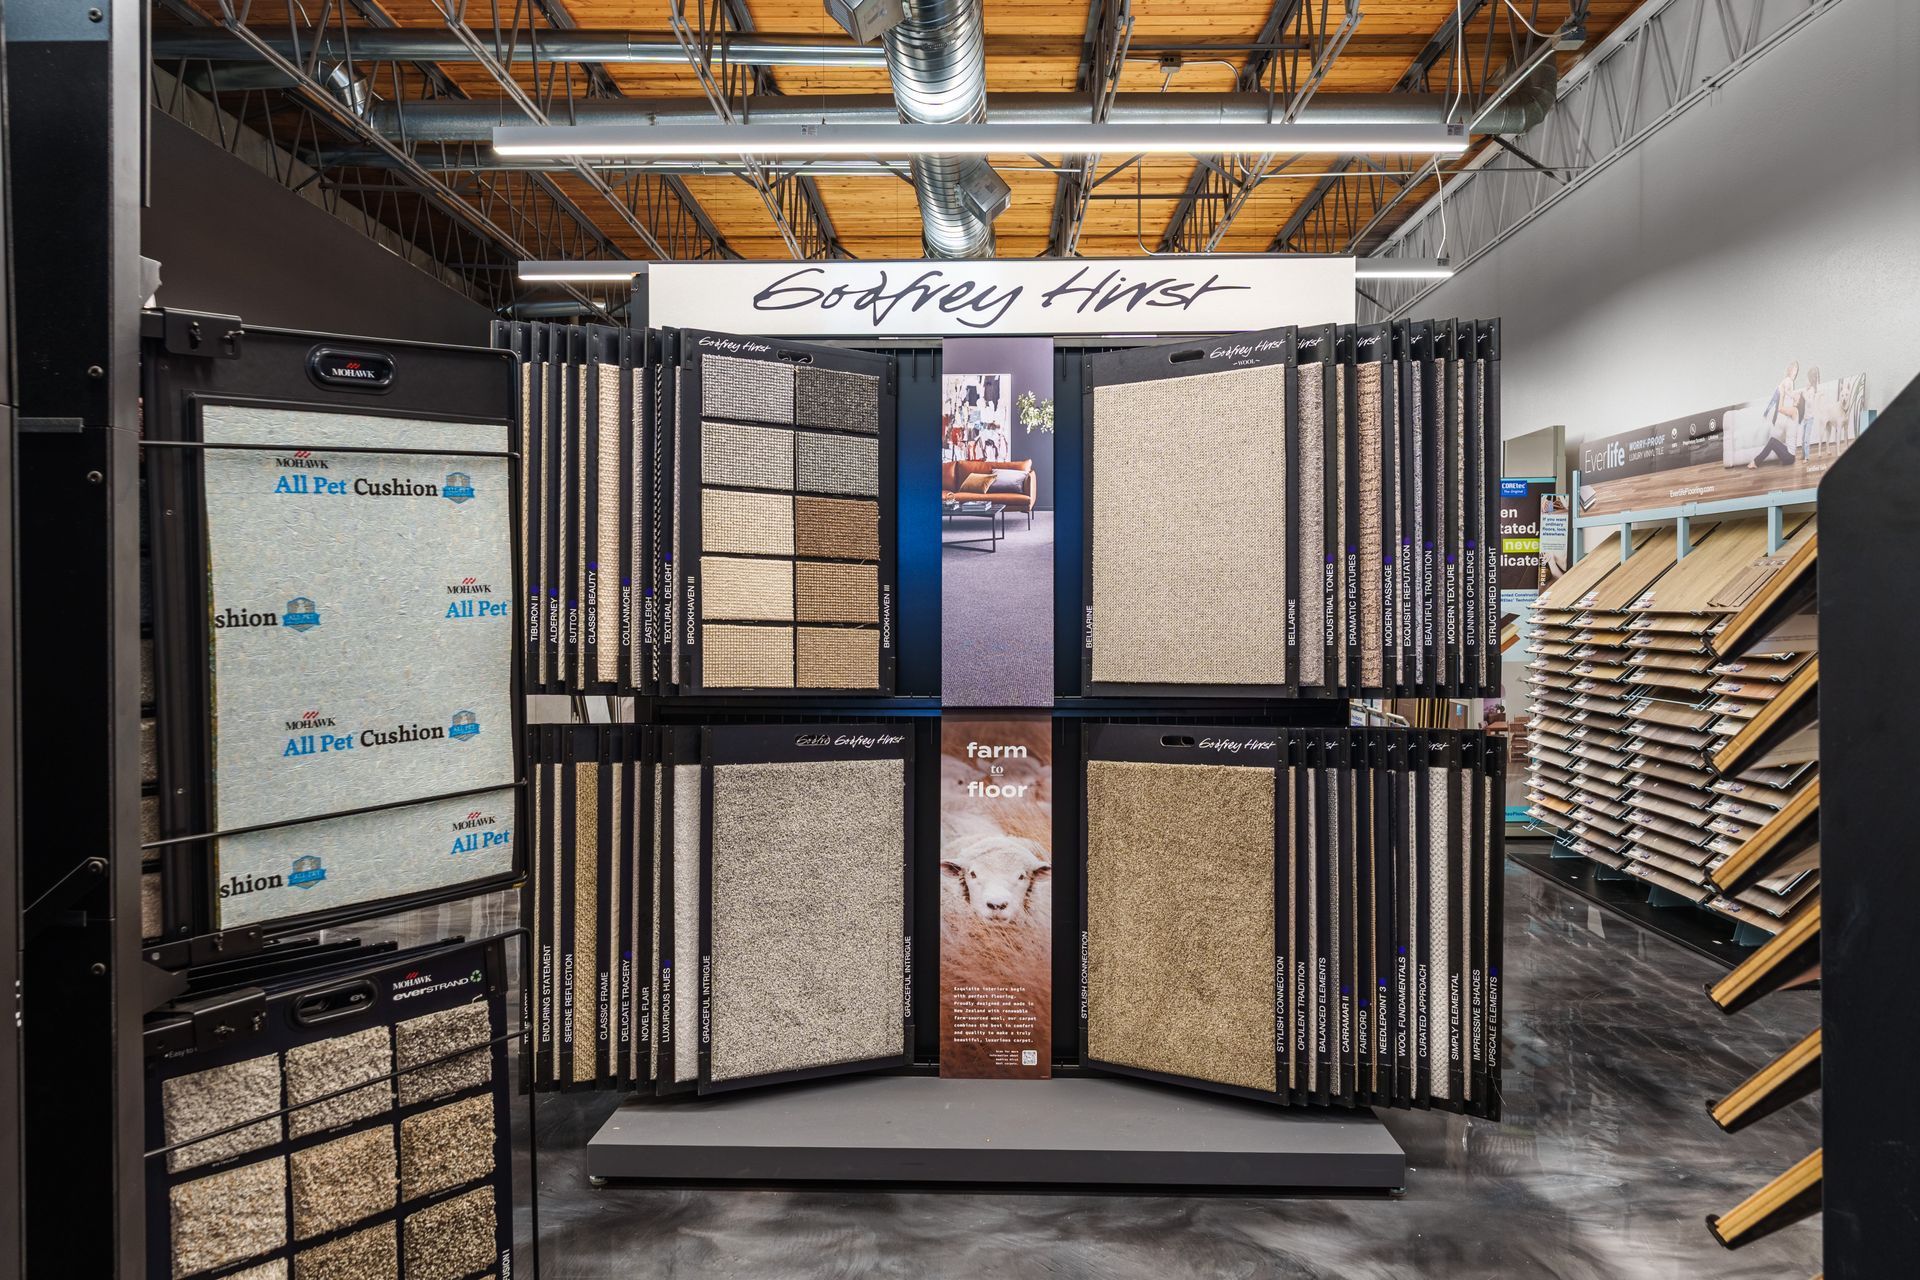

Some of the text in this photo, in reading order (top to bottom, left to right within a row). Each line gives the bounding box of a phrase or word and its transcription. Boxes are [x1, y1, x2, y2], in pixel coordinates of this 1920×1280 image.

[753, 266, 1251, 328] Godfrey Hirst
[698, 337, 772, 353] Godfrey Hirst
[1209, 338, 1286, 359] Godfrey Hirst
[1237, 358, 1255, 366] WOOL
[332, 367, 375, 379] MOHAWK
[275, 456, 330, 469] MOHAWK
[1585, 441, 1625, 473] Everlife
[274, 474, 438, 498] All Pet Cushion
[445, 600, 508, 619] All Pet
[447, 584, 492, 595] MOHAWK
[1326, 563, 1334, 646] INDUSTRIAL TONES
[1348, 554, 1357, 646] DRAMATIC FEATURES
[1384, 565, 1393, 646] MODERN PASSAGE
[1403, 544, 1412, 647] EXQUISITE REPUTATION
[1425, 550, 1433, 646] BEAUTIFUL TRADITION
[1447, 564, 1455, 644] MODERN TEXTURE
[1467, 550, 1475, 646] STUNNING OPULENCE
[1489, 547, 1497, 645] STRUCTURED DELIGHT
[530, 602, 538, 641] TIBURON
[588, 607, 596, 644] CLASSIC
[664, 601, 672, 644] TEXTURAL
[687, 586, 695, 645] BROOKHAVEN
[1086, 605, 1094, 648] BELLARINE
[1288, 599, 1296, 646] BELLARINE
[283, 726, 445, 757] All Pet Cushion
[285, 717, 337, 731] MOHAWK
[834, 734, 905, 748] Godfrey Hirst
[966, 742, 1027, 758] farm
[1198, 738, 1242, 753] Godfrey
[1244, 738, 1276, 750] Hirst
[967, 781, 1028, 798] floor
[990, 765, 1004, 774] to
[450, 830, 511, 855] All Pet
[452, 816, 496, 832] MOHAWK
[392, 974, 432, 991] MOHAWK
[392, 977, 469, 1001] everSTRAND
[543, 945, 551, 1042] ENDURING STATEMENT
[565, 954, 573, 1043] SERENE REFLECTION
[622, 960, 630, 1042] DELICATE TRACERY
[703, 955, 711, 1043] GRACEFUL INTRIGUE
[1398, 956, 1406, 1028] FUNDAMENTALS
[600, 1003, 608, 1040] CLASSIC
[641, 987, 650, 1041] NOVEL FLAIR
[663, 967, 671, 1042] LUXURIOUS HUES
[1379, 995, 1387, 1054] NEEDLEPOINT
[1419, 964, 1427, 1057] CURATED APPROACH
[1473, 969, 1481, 1061] IMPRESSIVE SHADES
[1451, 1027, 1459, 1060] SIMPLY
[1489, 1026, 1497, 1067] UPSCALE
